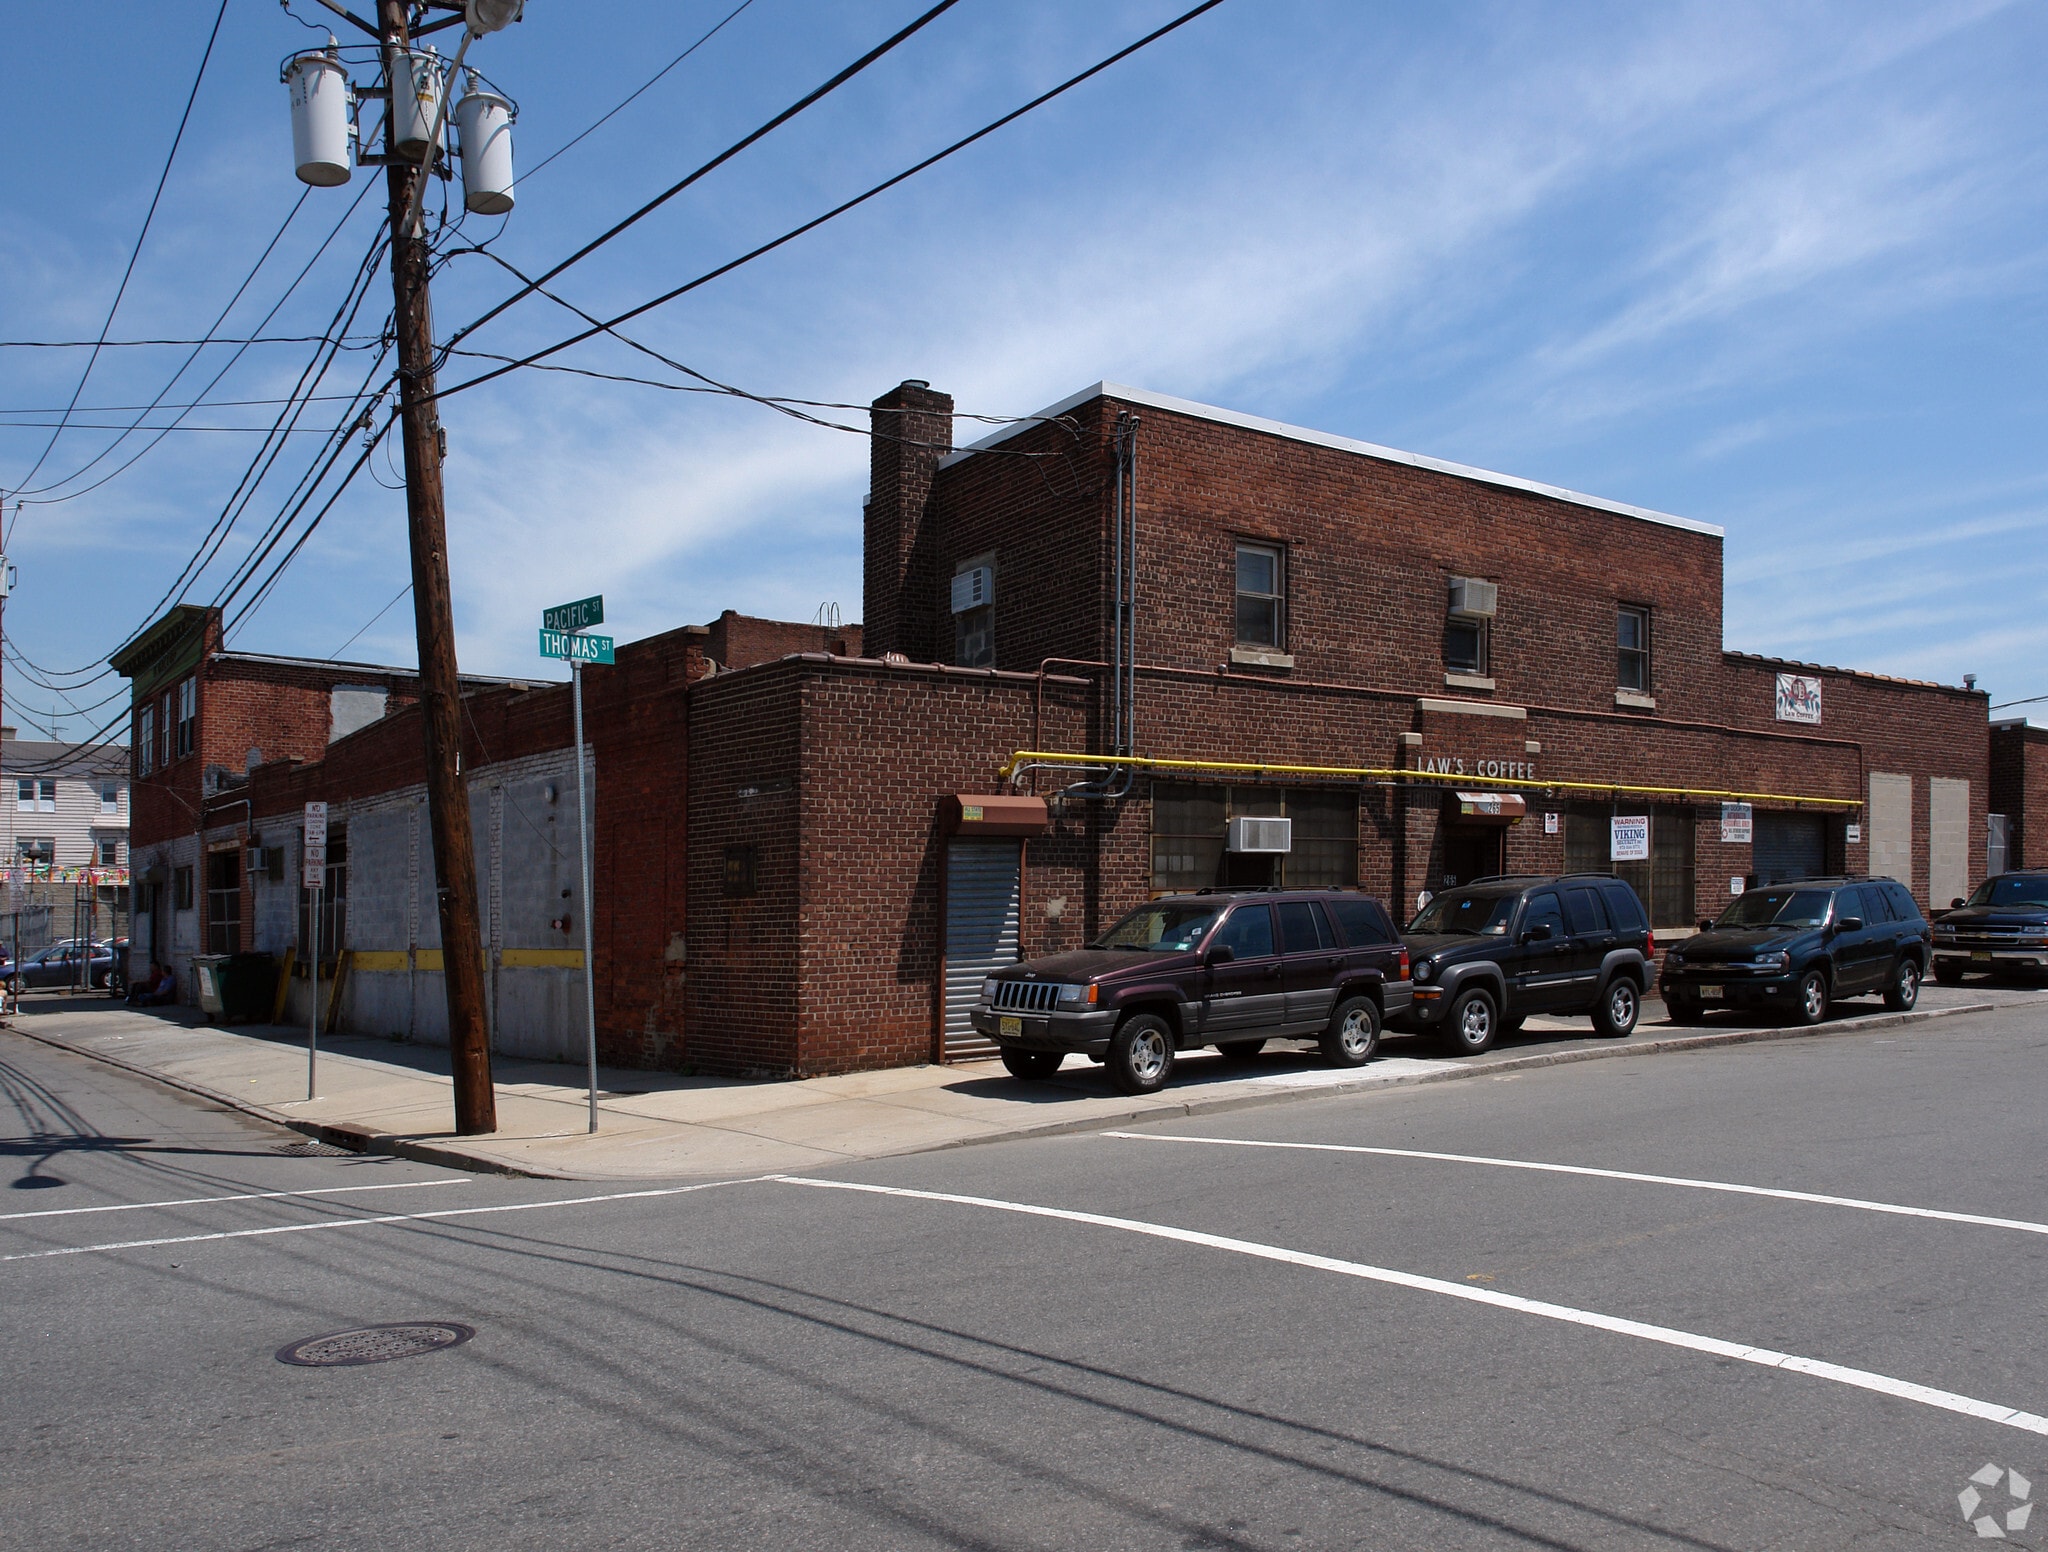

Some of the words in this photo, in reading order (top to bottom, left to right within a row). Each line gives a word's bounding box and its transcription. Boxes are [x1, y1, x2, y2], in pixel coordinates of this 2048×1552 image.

[546, 603, 588, 630] PACIFIC
[592, 600, 600, 612] ST
[543, 633, 598, 658] THOMAS
[601, 640, 610, 651] ST
[1418, 757, 1464, 775] LAW'S
[1477, 760, 1535, 779] COFFEE
[1614, 829, 1645, 839] VIKING
[311, 849, 319, 857] NO
